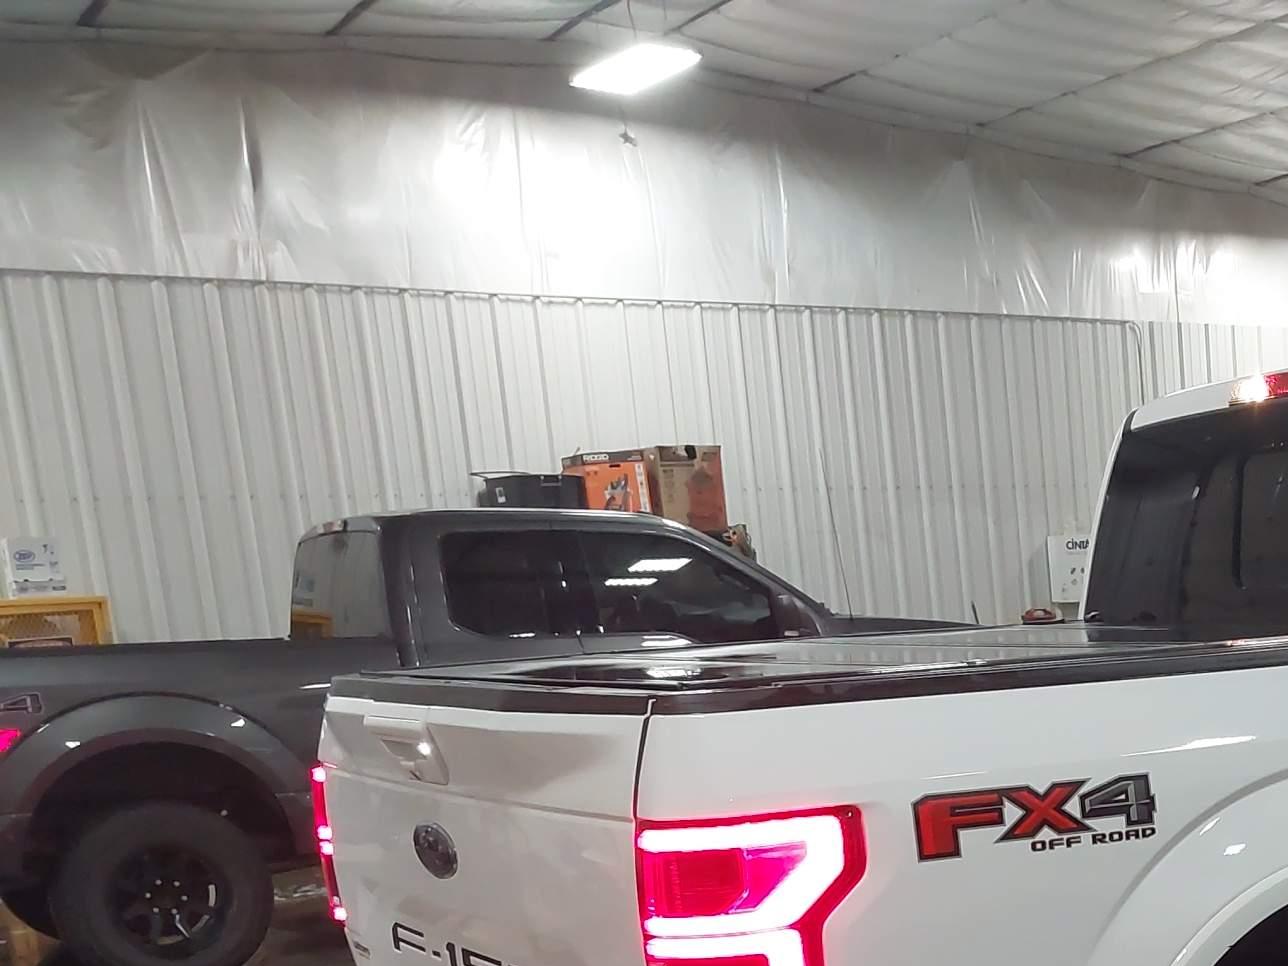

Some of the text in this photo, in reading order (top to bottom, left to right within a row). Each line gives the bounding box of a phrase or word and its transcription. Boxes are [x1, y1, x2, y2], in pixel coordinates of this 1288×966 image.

[911, 772, 1157, 863] FX4
[1030, 827, 1157, 853] OFF ROAD
